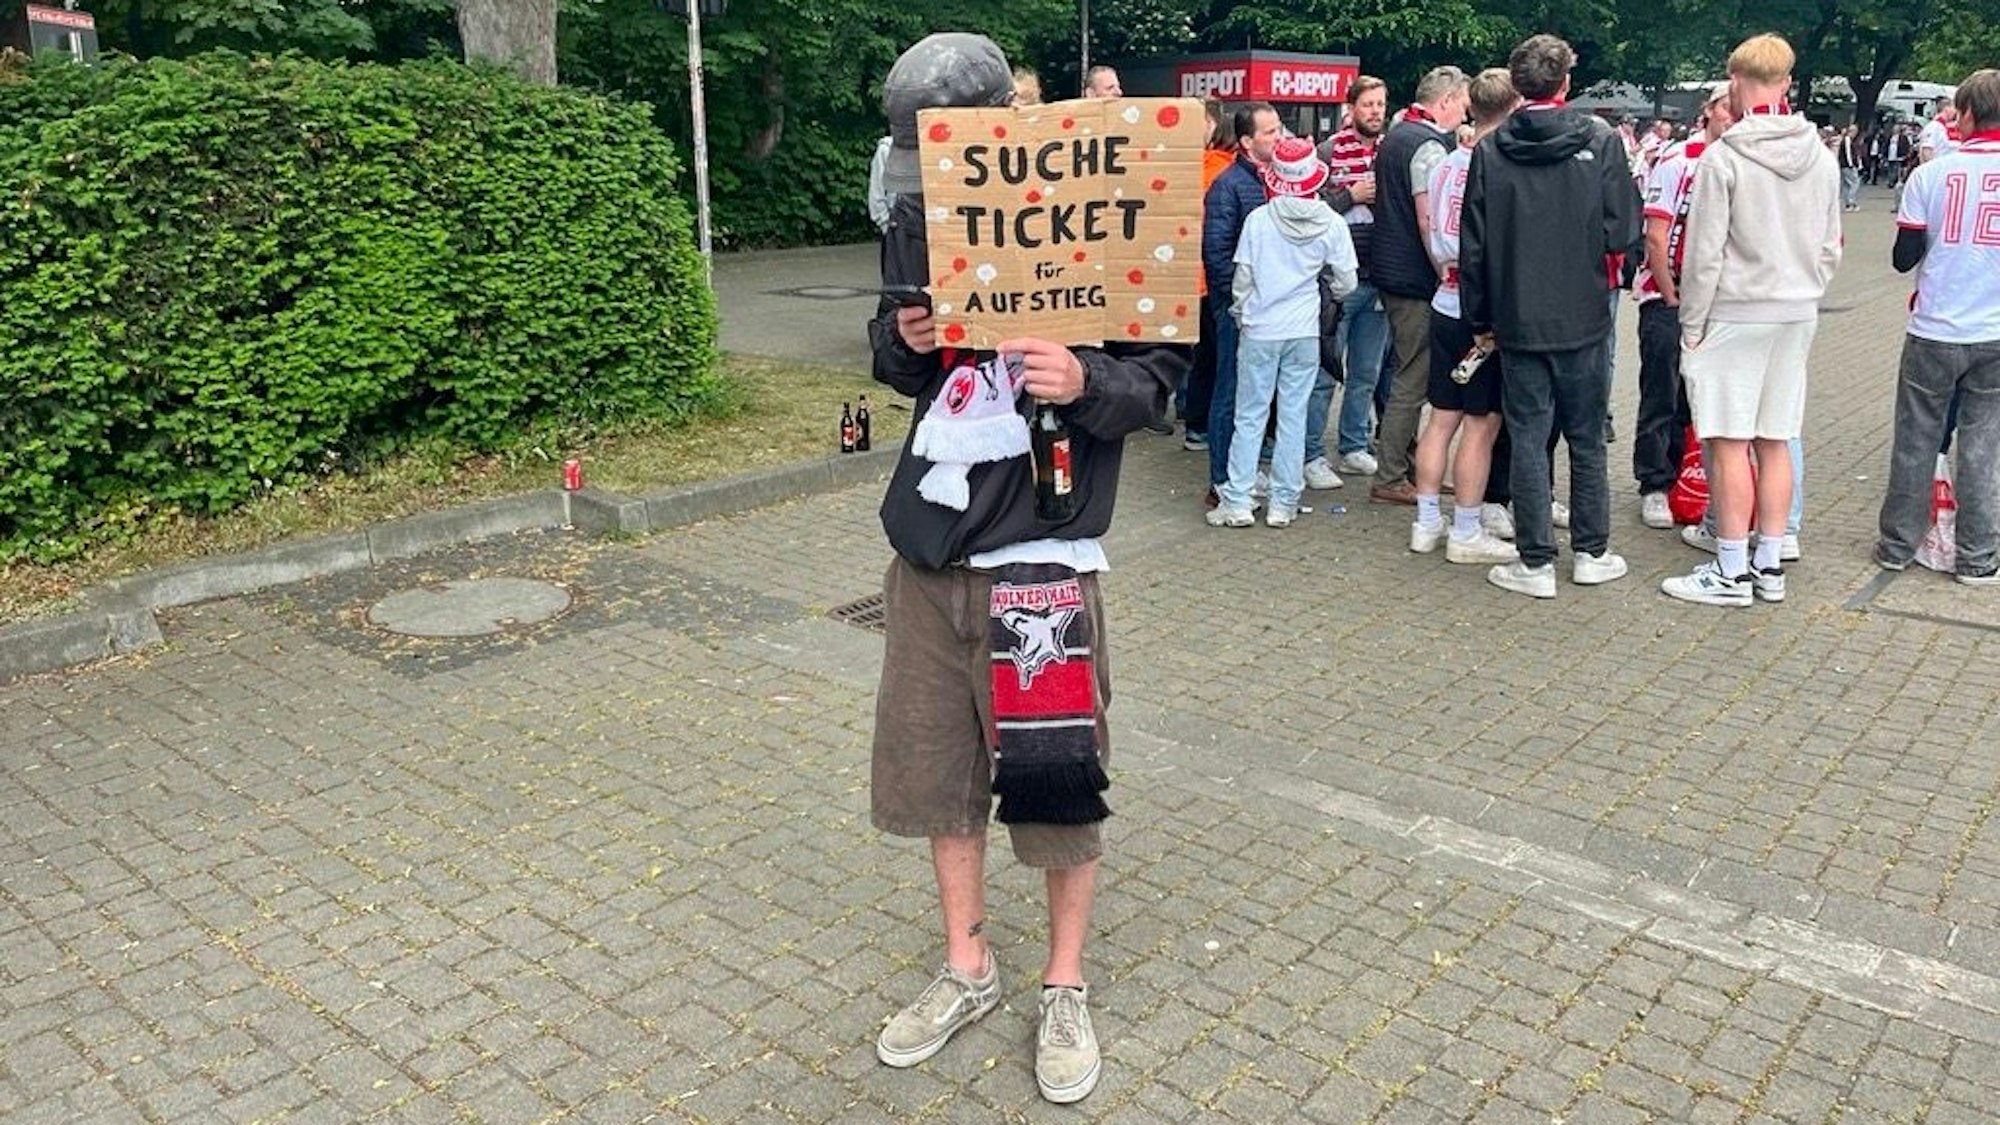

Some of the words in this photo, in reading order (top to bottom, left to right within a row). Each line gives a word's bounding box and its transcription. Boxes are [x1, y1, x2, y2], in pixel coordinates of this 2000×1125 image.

[1181, 69, 1247, 97] DEPOT
[1271, 70, 1340, 96] FC-DEPOT
[963, 136, 1130, 187] SUCHE
[956, 199, 1147, 248] TICKET
[1944, 173, 2000, 246] 12
[1034, 262, 1066, 280] für
[964, 285, 1107, 313] AUFSTIEG
